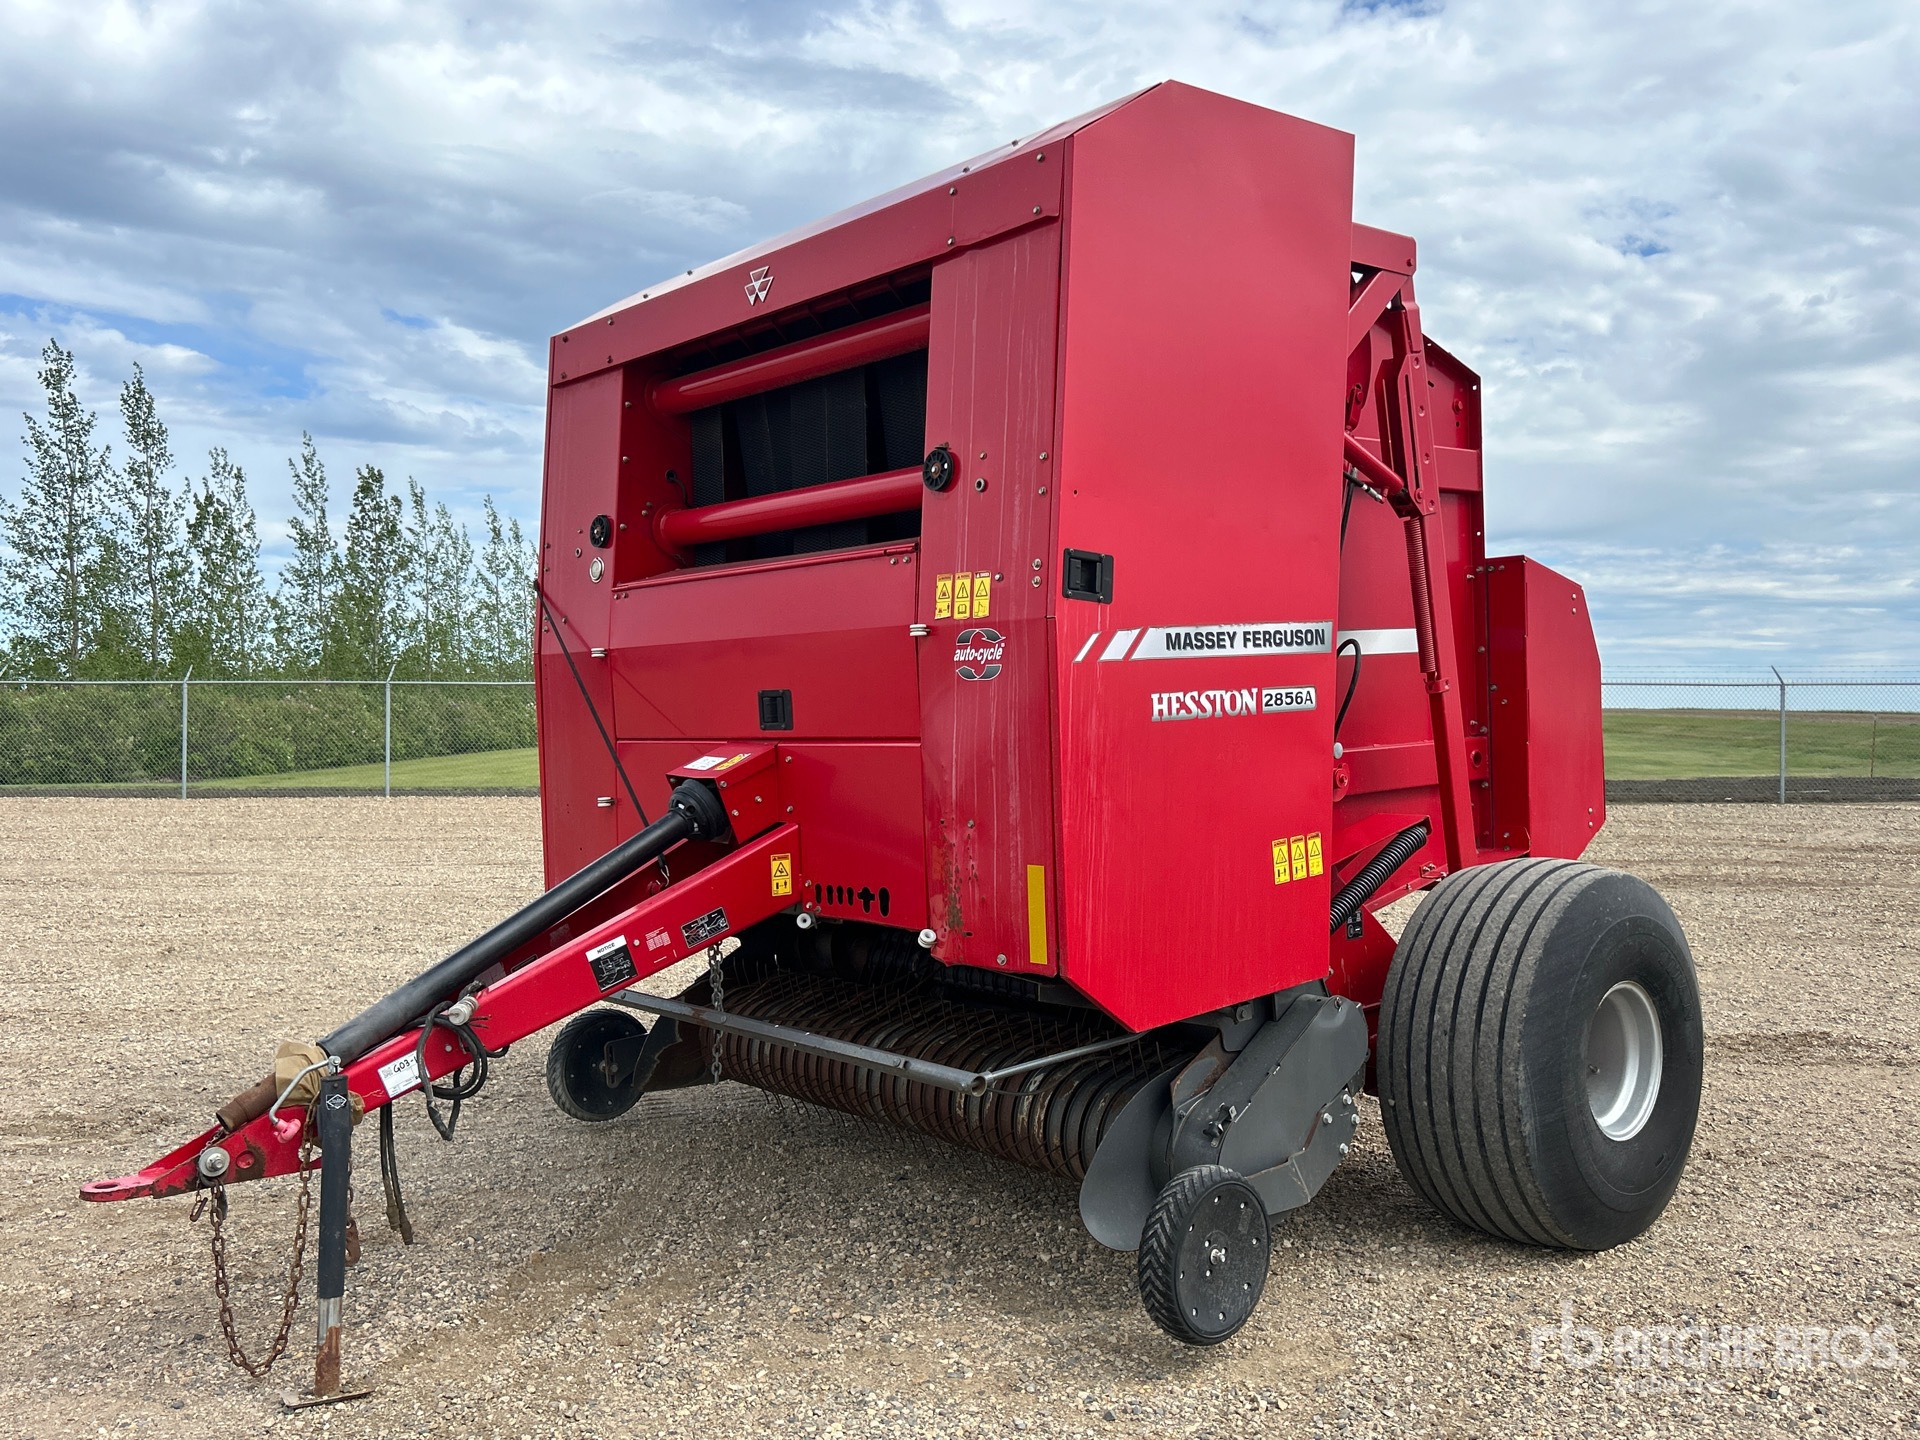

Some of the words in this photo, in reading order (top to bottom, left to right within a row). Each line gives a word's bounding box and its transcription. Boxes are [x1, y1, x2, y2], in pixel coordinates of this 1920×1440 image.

[1165, 631, 1237, 651] MASSEY
[1243, 628, 1326, 649] FERGUSON
[1151, 688, 1258, 722] HESSTON
[1264, 690, 1313, 707] 2856A
[596, 942, 616, 955] NOTICE
